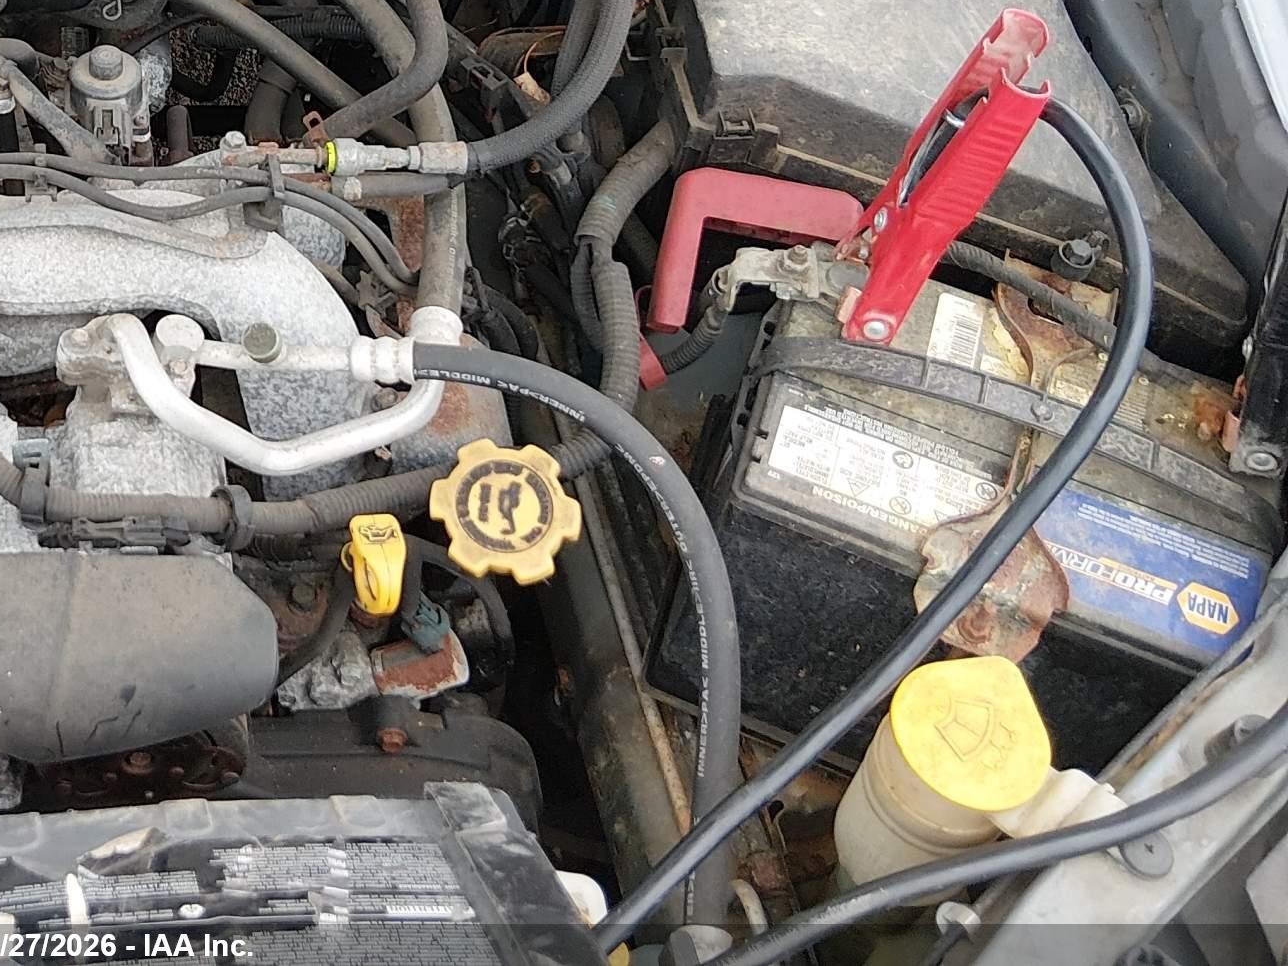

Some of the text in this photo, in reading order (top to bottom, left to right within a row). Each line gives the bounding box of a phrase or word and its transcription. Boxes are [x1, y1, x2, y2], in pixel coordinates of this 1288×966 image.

[614, 443, 689, 553] OUTER>EPDM<
[1047, 542, 1175, 605] PROFORM
[1186, 591, 1230, 624] NAPA
[697, 676, 710, 778] INNER>PA<
